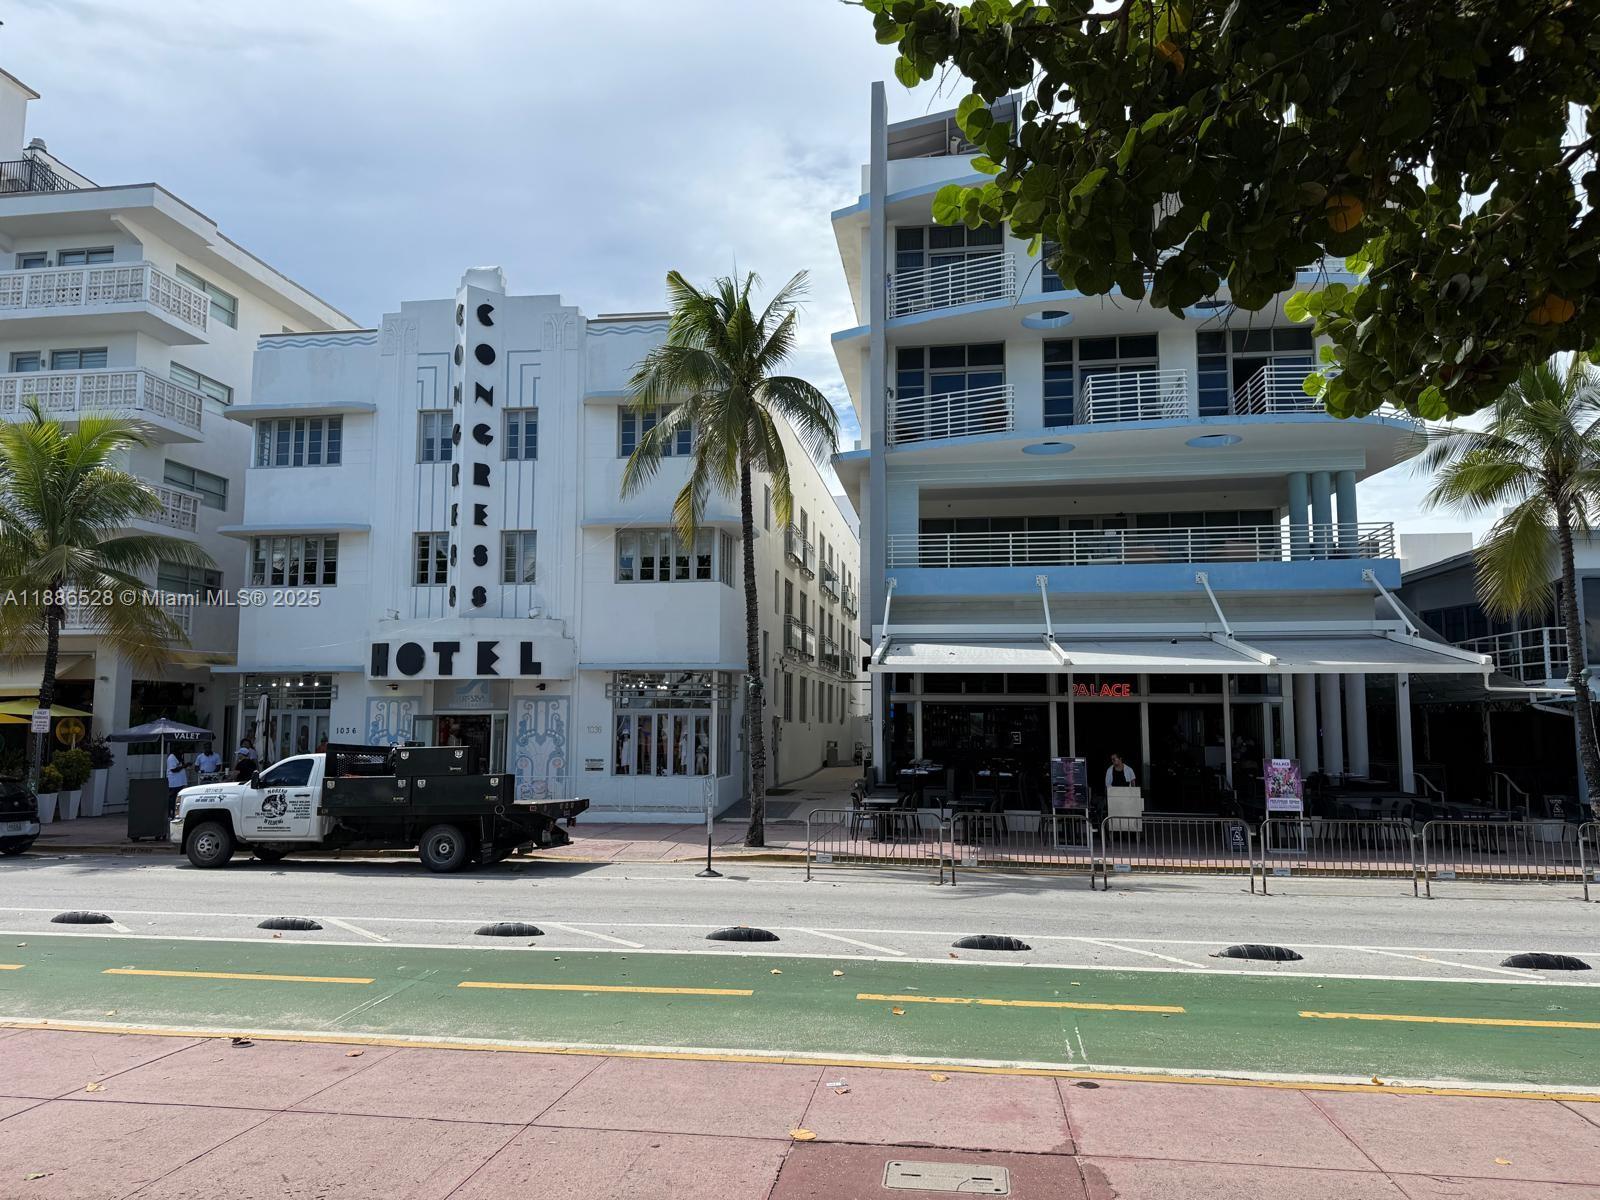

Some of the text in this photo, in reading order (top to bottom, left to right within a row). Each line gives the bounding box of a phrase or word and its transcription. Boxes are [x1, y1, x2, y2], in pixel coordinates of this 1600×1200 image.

[471, 303, 497, 608] CONGRESS
[370, 641, 542, 676] HOTEL
[1072, 683, 1131, 697] PALACE
[174, 732, 201, 740] VALET
[336, 727, 357, 735] 1036
